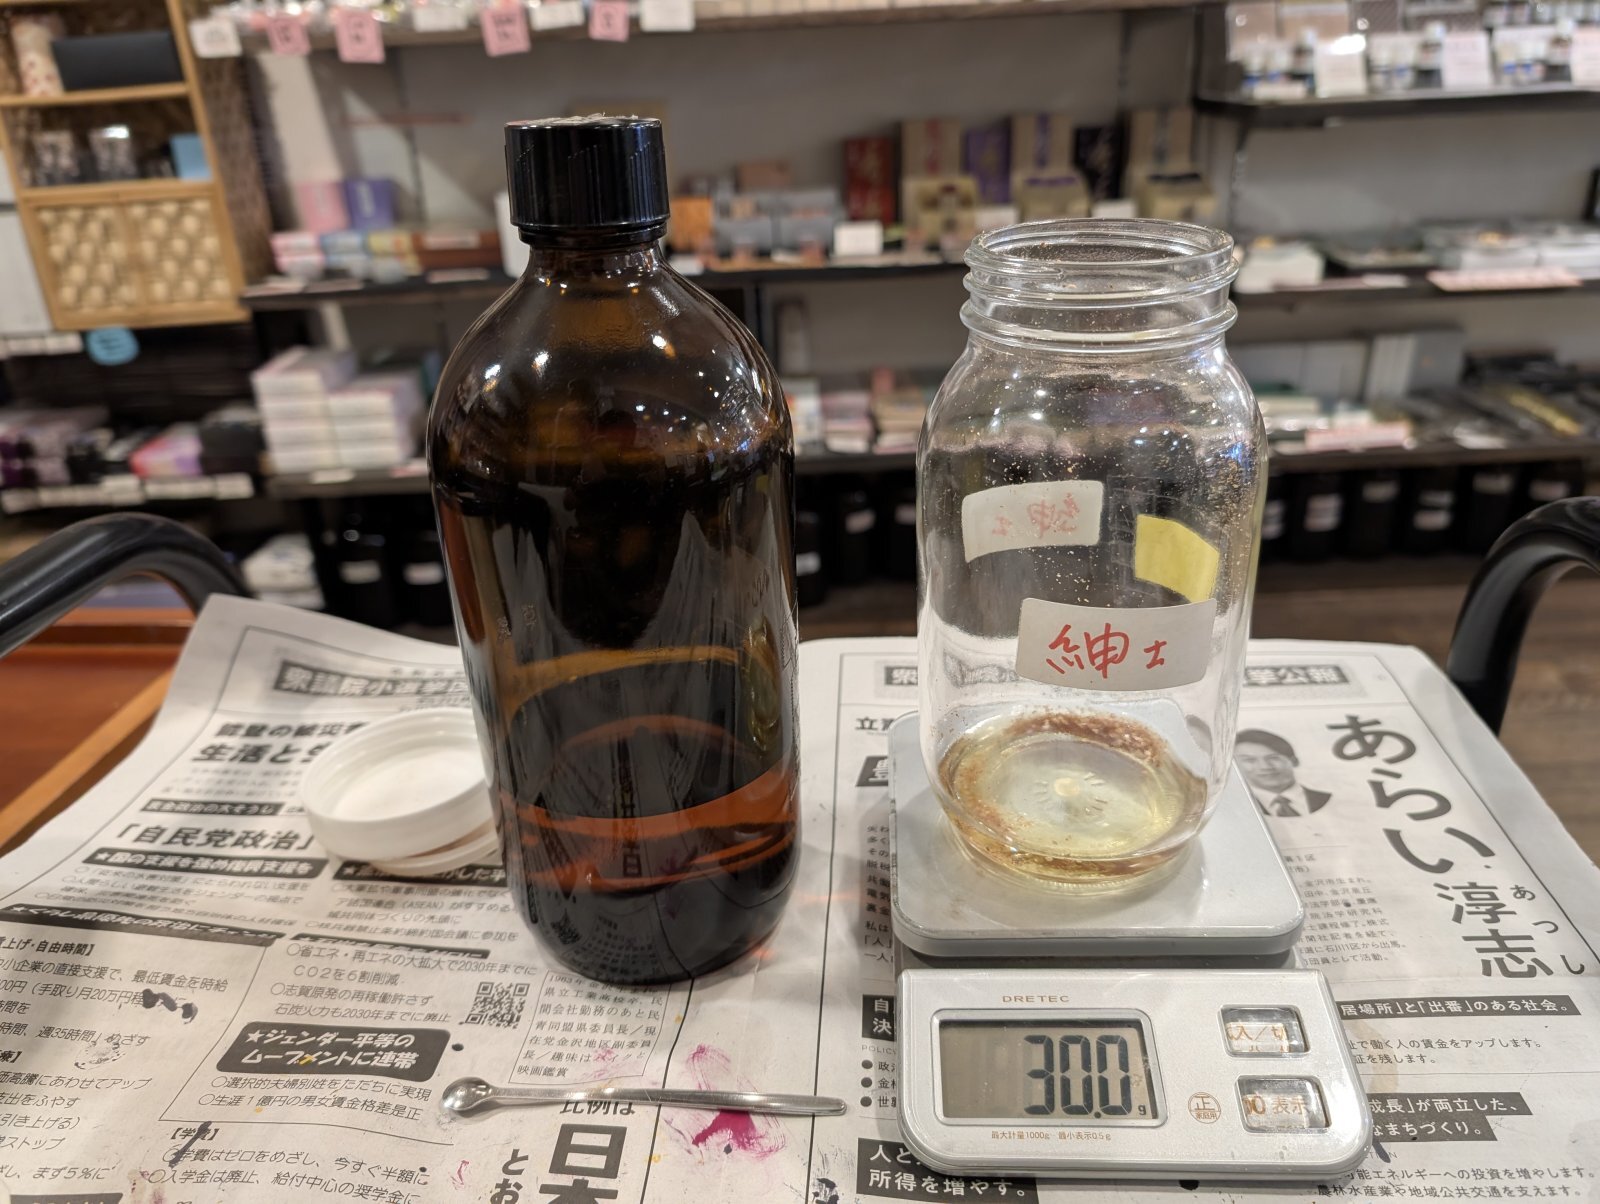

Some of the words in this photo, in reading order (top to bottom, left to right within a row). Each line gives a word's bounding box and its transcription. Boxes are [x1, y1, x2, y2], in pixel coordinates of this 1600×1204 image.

[1045, 622, 1168, 679] 紳士
[1327, 715, 1496, 874] あらい
[117, 823, 316, 851] 「自民党政治」
[1002, 995, 1070, 1003] DRETEC
[869, 1168, 1026, 1197] 所得を増やす。
